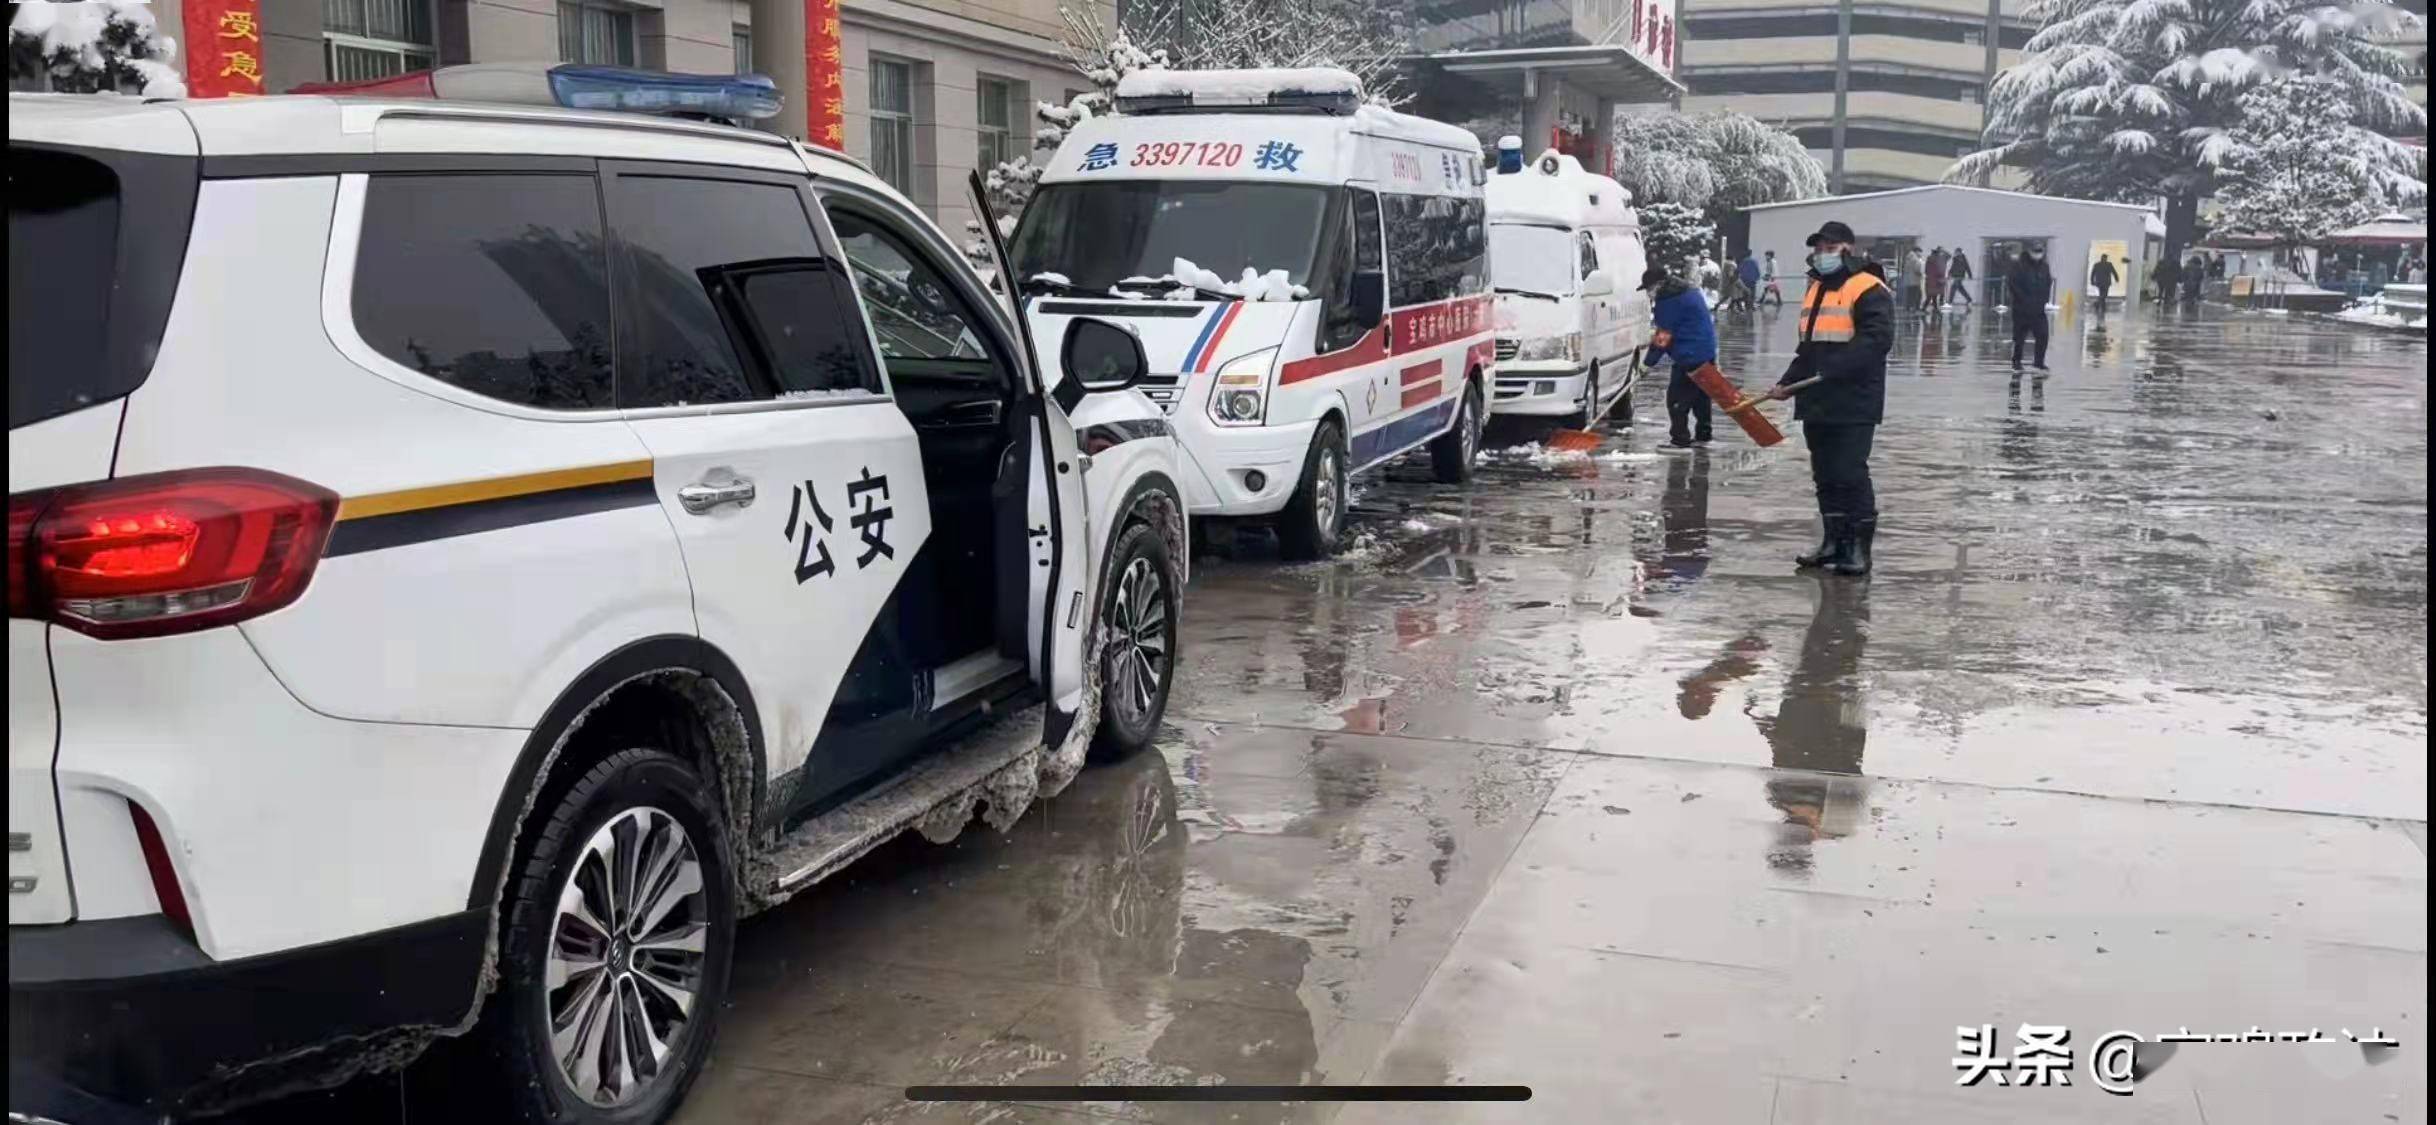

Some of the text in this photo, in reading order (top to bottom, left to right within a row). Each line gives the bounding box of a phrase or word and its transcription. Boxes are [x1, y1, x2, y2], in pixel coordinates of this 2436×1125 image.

[217, 0, 262, 97] 受急
[1077, 140, 1304, 172] 急 3397120 救
[784, 465, 894, 585] 公安
